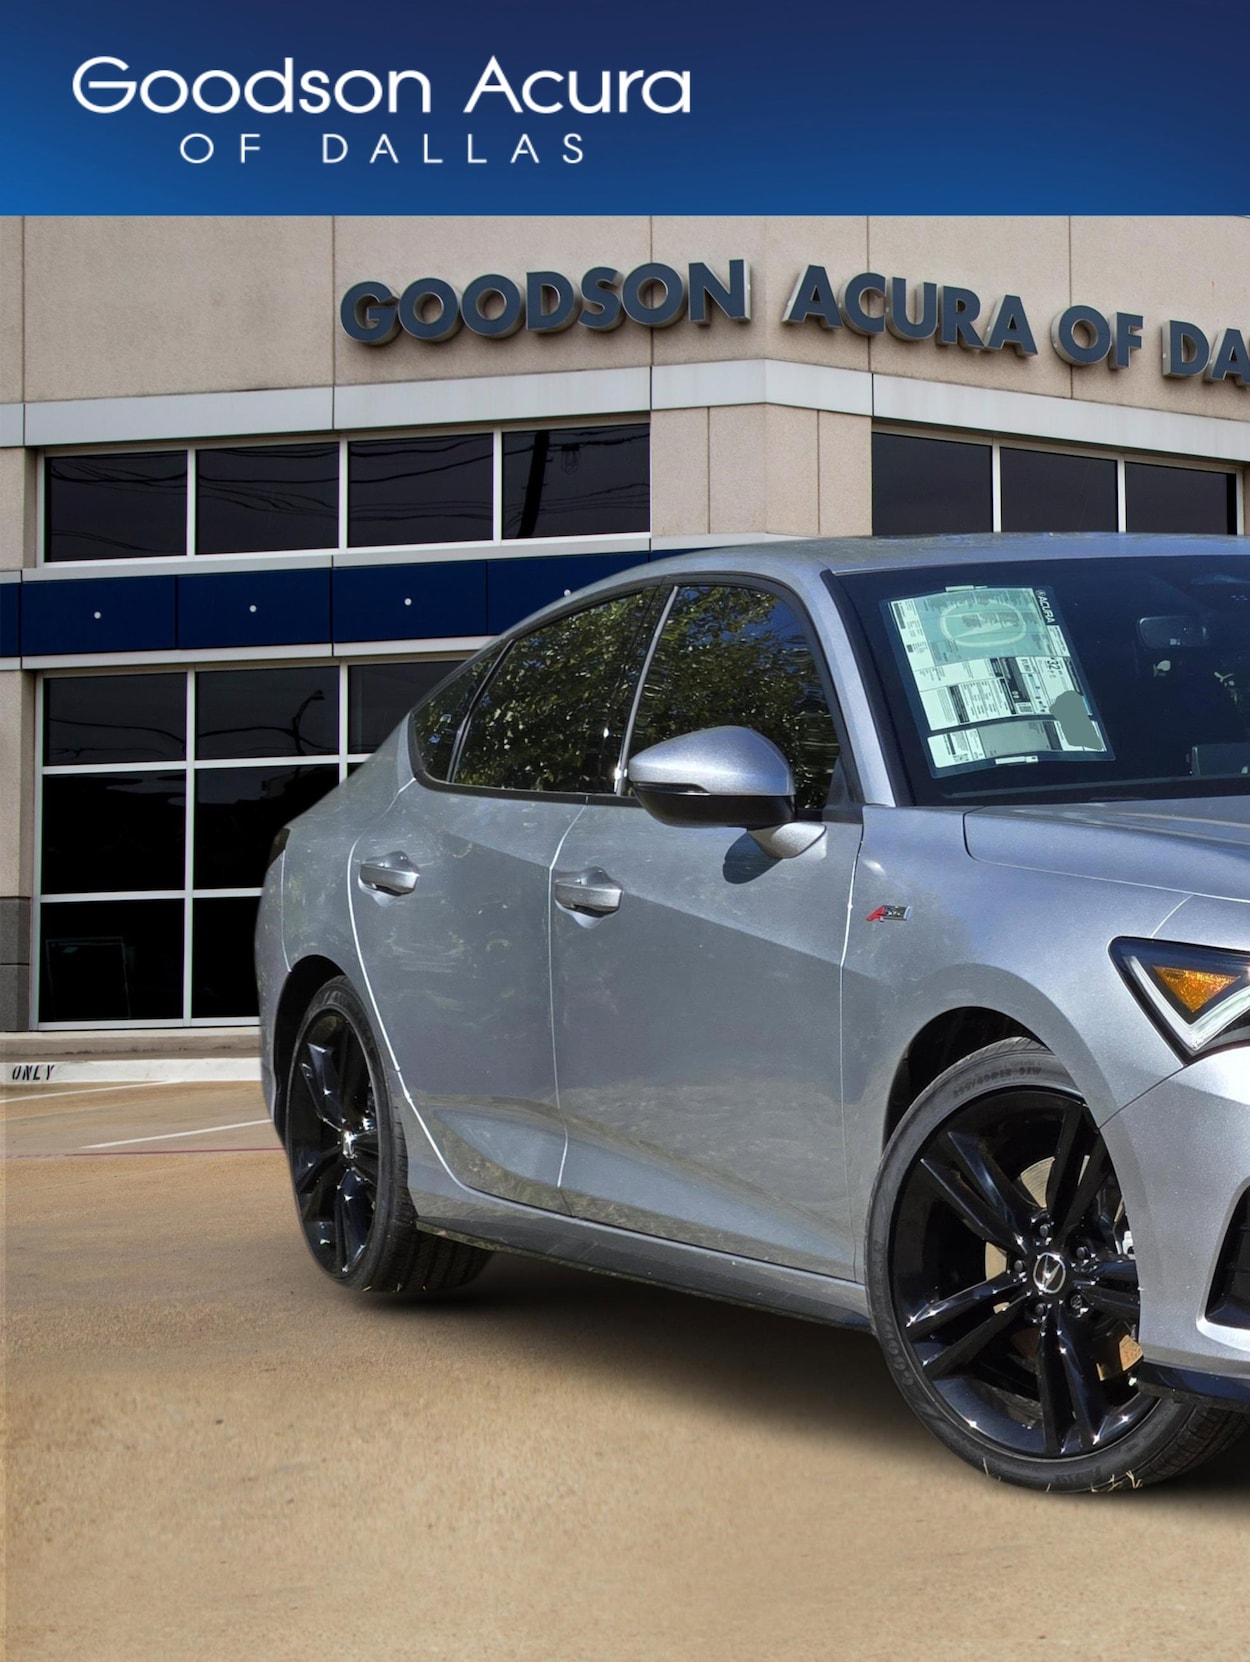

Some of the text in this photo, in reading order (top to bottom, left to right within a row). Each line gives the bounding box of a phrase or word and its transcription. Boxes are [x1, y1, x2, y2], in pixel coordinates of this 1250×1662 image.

[341, 259, 750, 345] GOODSON
[783, 264, 1038, 356] ACURA
[1053, 305, 1145, 369] OF
[1038, 595, 1056, 624] ACURA
[12, 1064, 55, 1081] ONLY
